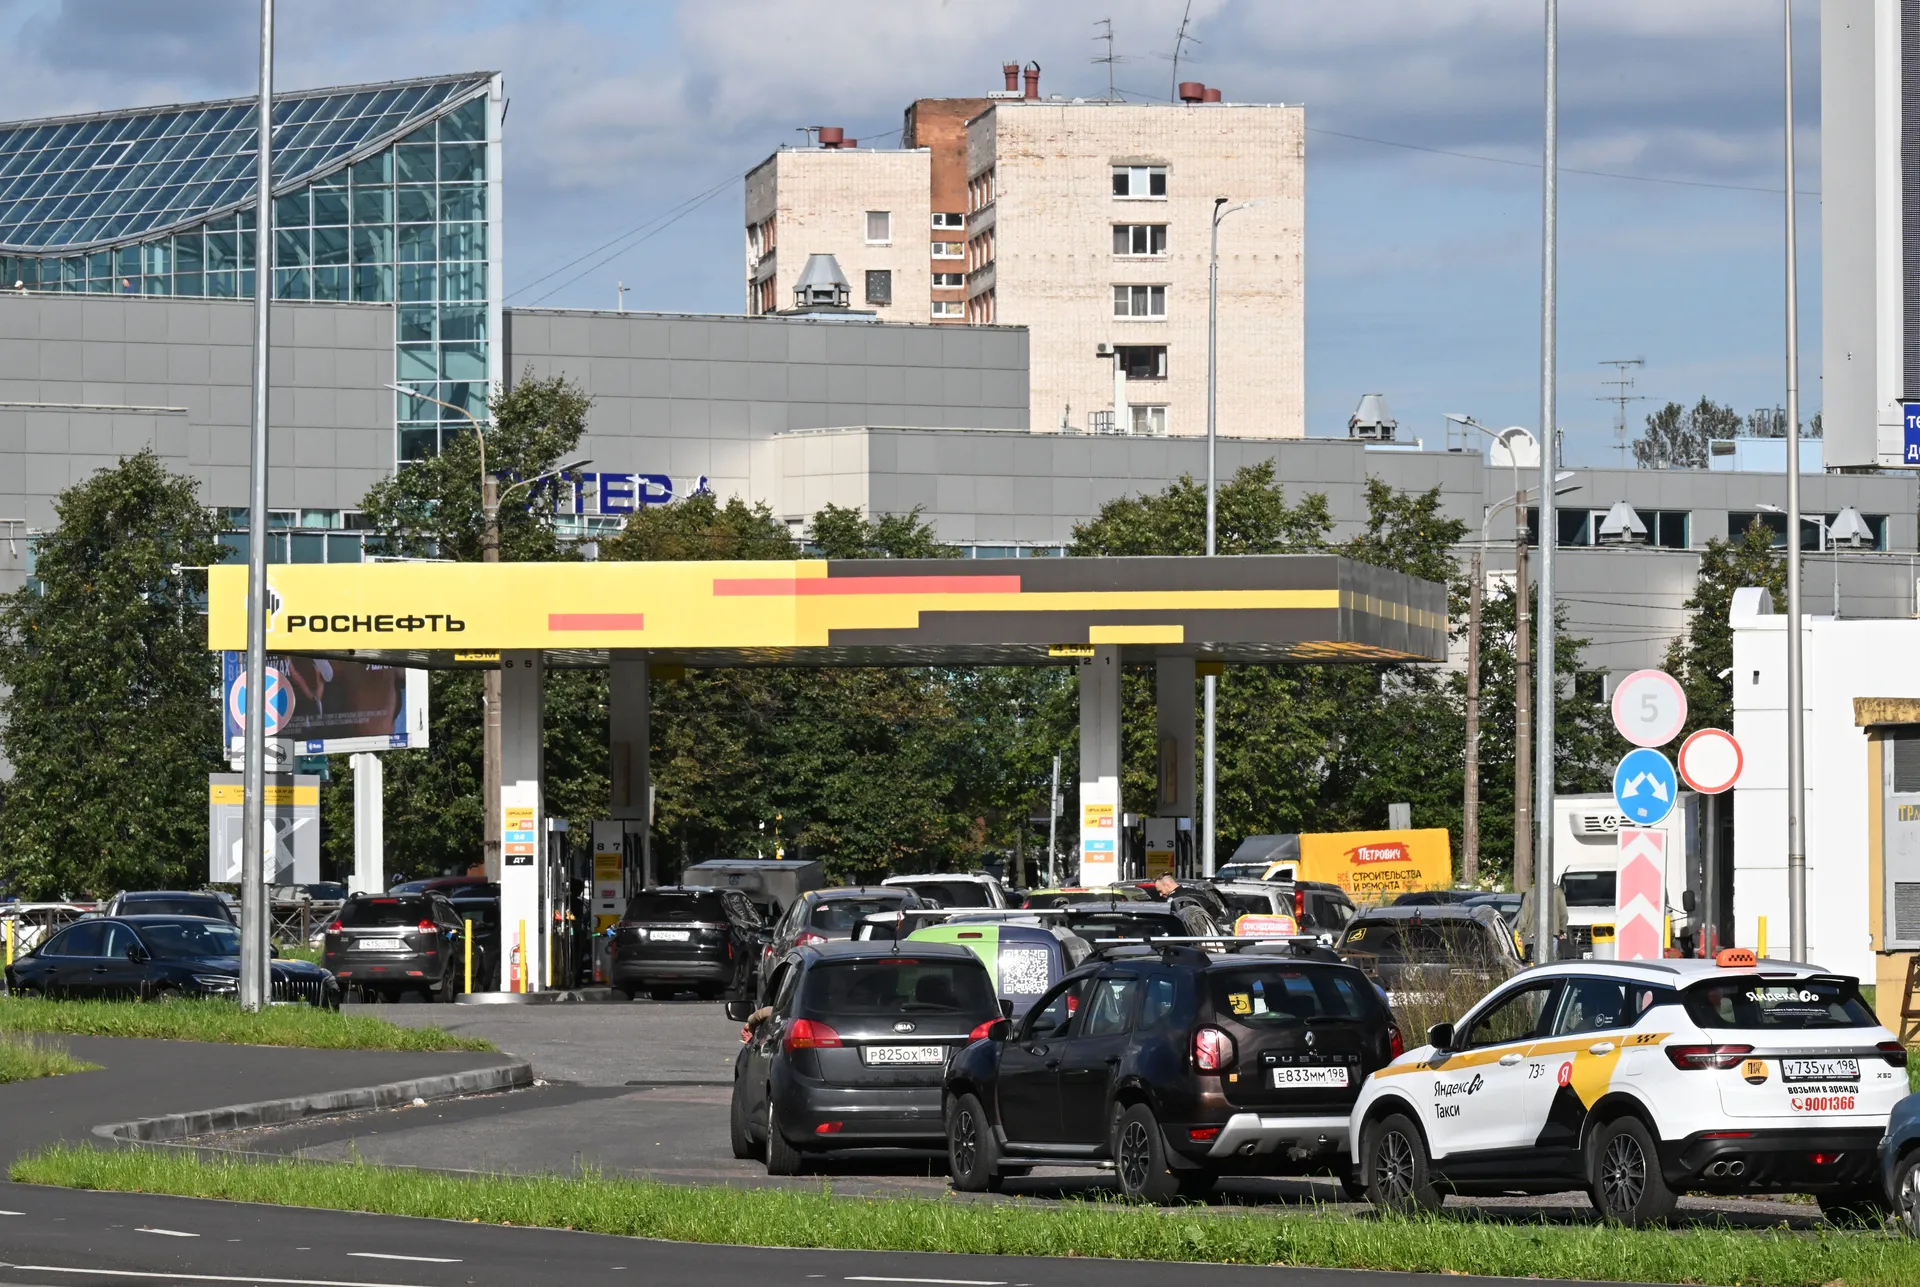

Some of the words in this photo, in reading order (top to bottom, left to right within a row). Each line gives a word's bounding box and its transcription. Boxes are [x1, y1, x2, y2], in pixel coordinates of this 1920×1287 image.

[288, 615, 465, 632] РОСНЕФТЬ
[505, 659, 514, 668] 6
[524, 659, 532, 668] 5
[1084, 657, 1092, 665] 2
[1105, 656, 1110, 665] 1
[1640, 694, 1659, 723] 5
[597, 843, 605, 851] 8
[612, 842, 621, 851] 7
[1147, 840, 1155, 849] 4
[1166, 840, 1175, 848] 3
[1352, 870, 1422, 881] СТРОИТЕЛЬСТВА
[1354, 882, 1360, 892] И
[1362, 881, 1400, 891] РЕМОНТА
[1746, 992, 1800, 1002] Яндекс
[1528, 1064, 1546, 1079] 735
[1560, 1065, 1570, 1083] Я
[1434, 1080, 1470, 1097] Яндекс
[1822, 1086, 1828, 1094] в
[1829, 1085, 1859, 1095] аренду
[1805, 1096, 1855, 1111] 9001366
[1435, 1103, 1460, 1118] Такси
